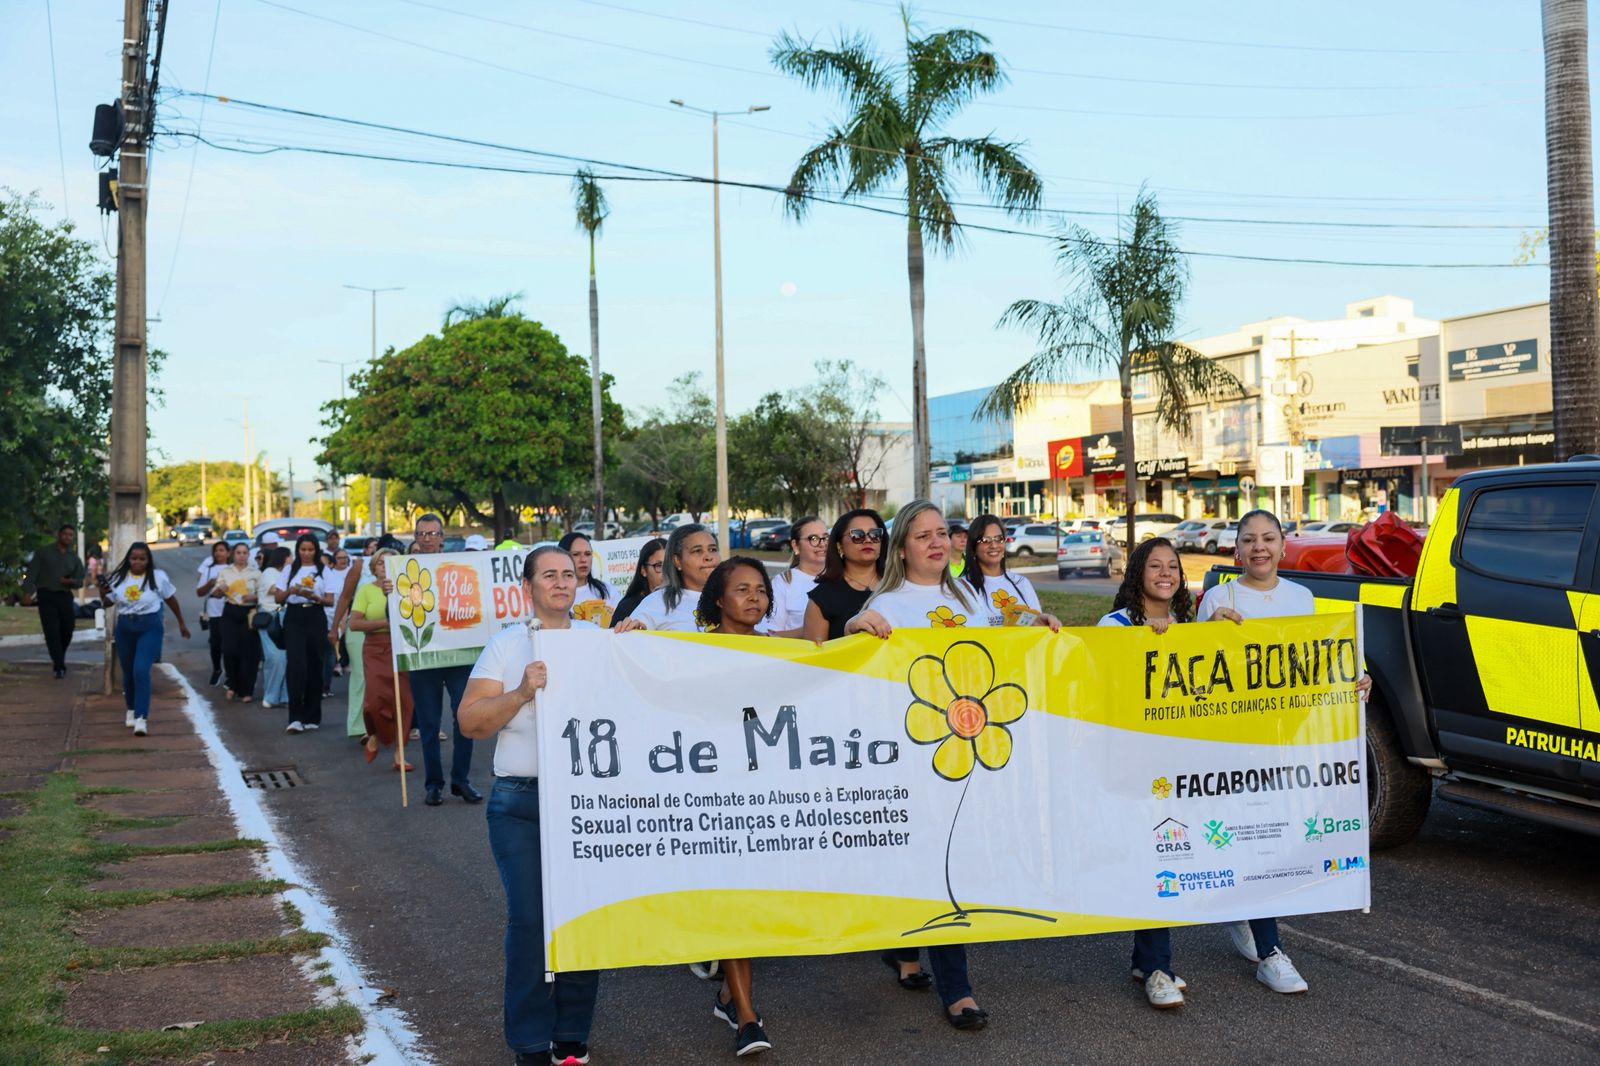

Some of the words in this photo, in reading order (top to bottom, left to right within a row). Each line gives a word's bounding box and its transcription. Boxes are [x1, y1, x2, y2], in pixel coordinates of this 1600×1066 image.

[1462, 437, 1476, 449] ocê
[608, 550, 628, 560] JUNTOS
[630, 549, 640, 558] PEL
[443, 570, 458, 597] 18
[460, 575, 473, 596] de
[446, 597, 475, 622] Maio
[1145, 649, 1235, 702] FAÇA
[1244, 638, 1357, 690] BONITO
[1144, 704, 1186, 721] PROTEJA
[1189, 701, 1227, 718] NOSSAS
[1231, 697, 1277, 715] CRIANÇAS
[1280, 698, 1285, 709] E
[1289, 690, 1358, 708] ADOLESCENTES
[561, 717, 622, 779] 18
[648, 730, 718, 774] de
[742, 705, 899, 771] Maio
[1176, 760, 1361, 798] FACABONITO.ORG
[571, 795, 594, 809] Dia
[598, 793, 660, 809] Nacional
[664, 793, 680, 807] de
[684, 792, 745, 807] Combate
[749, 793, 765, 806] ao
[768, 790, 810, 805] Abuso
[814, 791, 821, 803] e
[825, 787, 833, 802] à
[837, 785, 909, 804] Exploração
[571, 815, 631, 834] Sexual
[637, 814, 693, 833] contra
[699, 812, 776, 834] Crianças
[781, 813, 790, 828] e
[795, 806, 908, 828] Adolescentes
[1323, 817, 1360, 833] Bras
[572, 841, 651, 862] Esquecer
[656, 837, 665, 856] é
[670, 836, 742, 856] Permitir,
[747, 834, 814, 852] Lembrar
[819, 831, 828, 849] é
[832, 829, 910, 848] Combater
[1156, 841, 1191, 853] CRAS
[1179, 870, 1234, 882] CONSELHO
[1324, 856, 1366, 872] PALMA
[1180, 879, 1235, 891] TUTELAR
